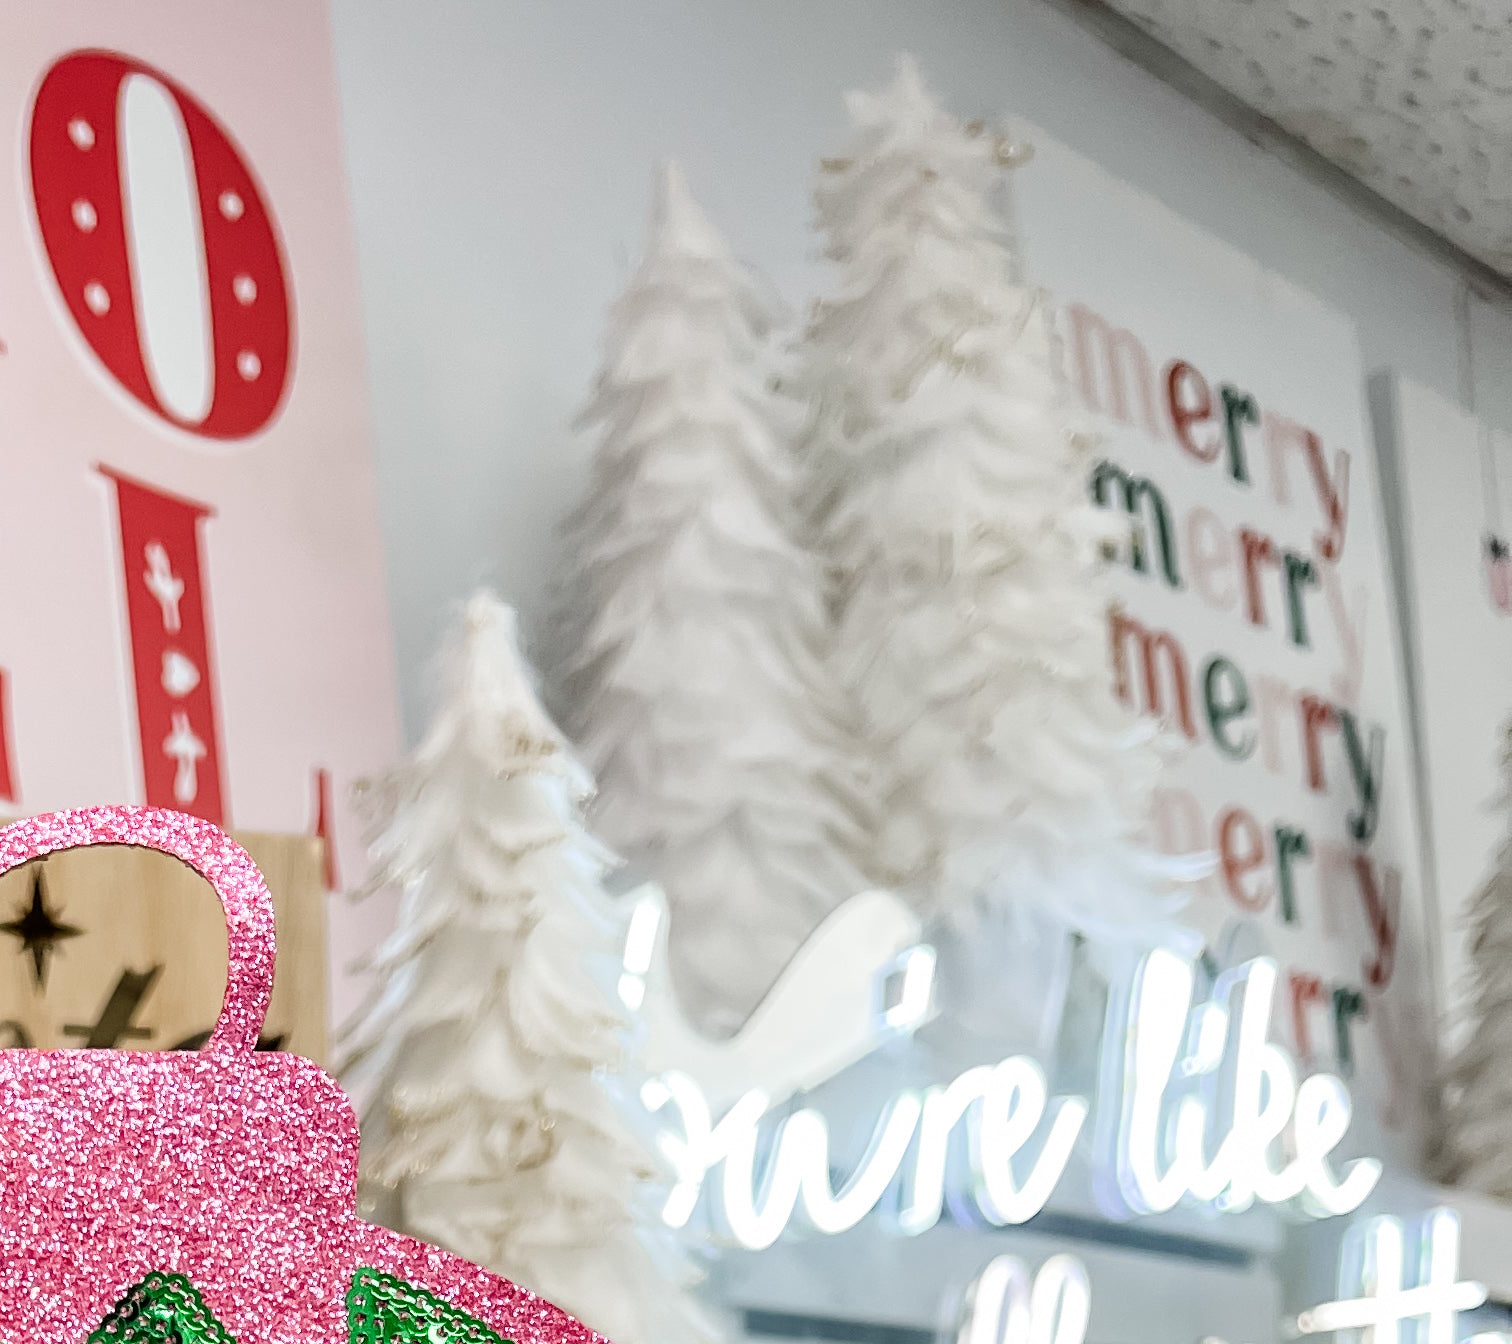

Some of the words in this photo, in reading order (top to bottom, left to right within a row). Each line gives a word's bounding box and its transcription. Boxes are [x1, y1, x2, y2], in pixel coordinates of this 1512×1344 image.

[1066, 303, 1350, 562] merry
[1106, 603, 1386, 842] merry
[1120, 948, 1382, 1217] like
